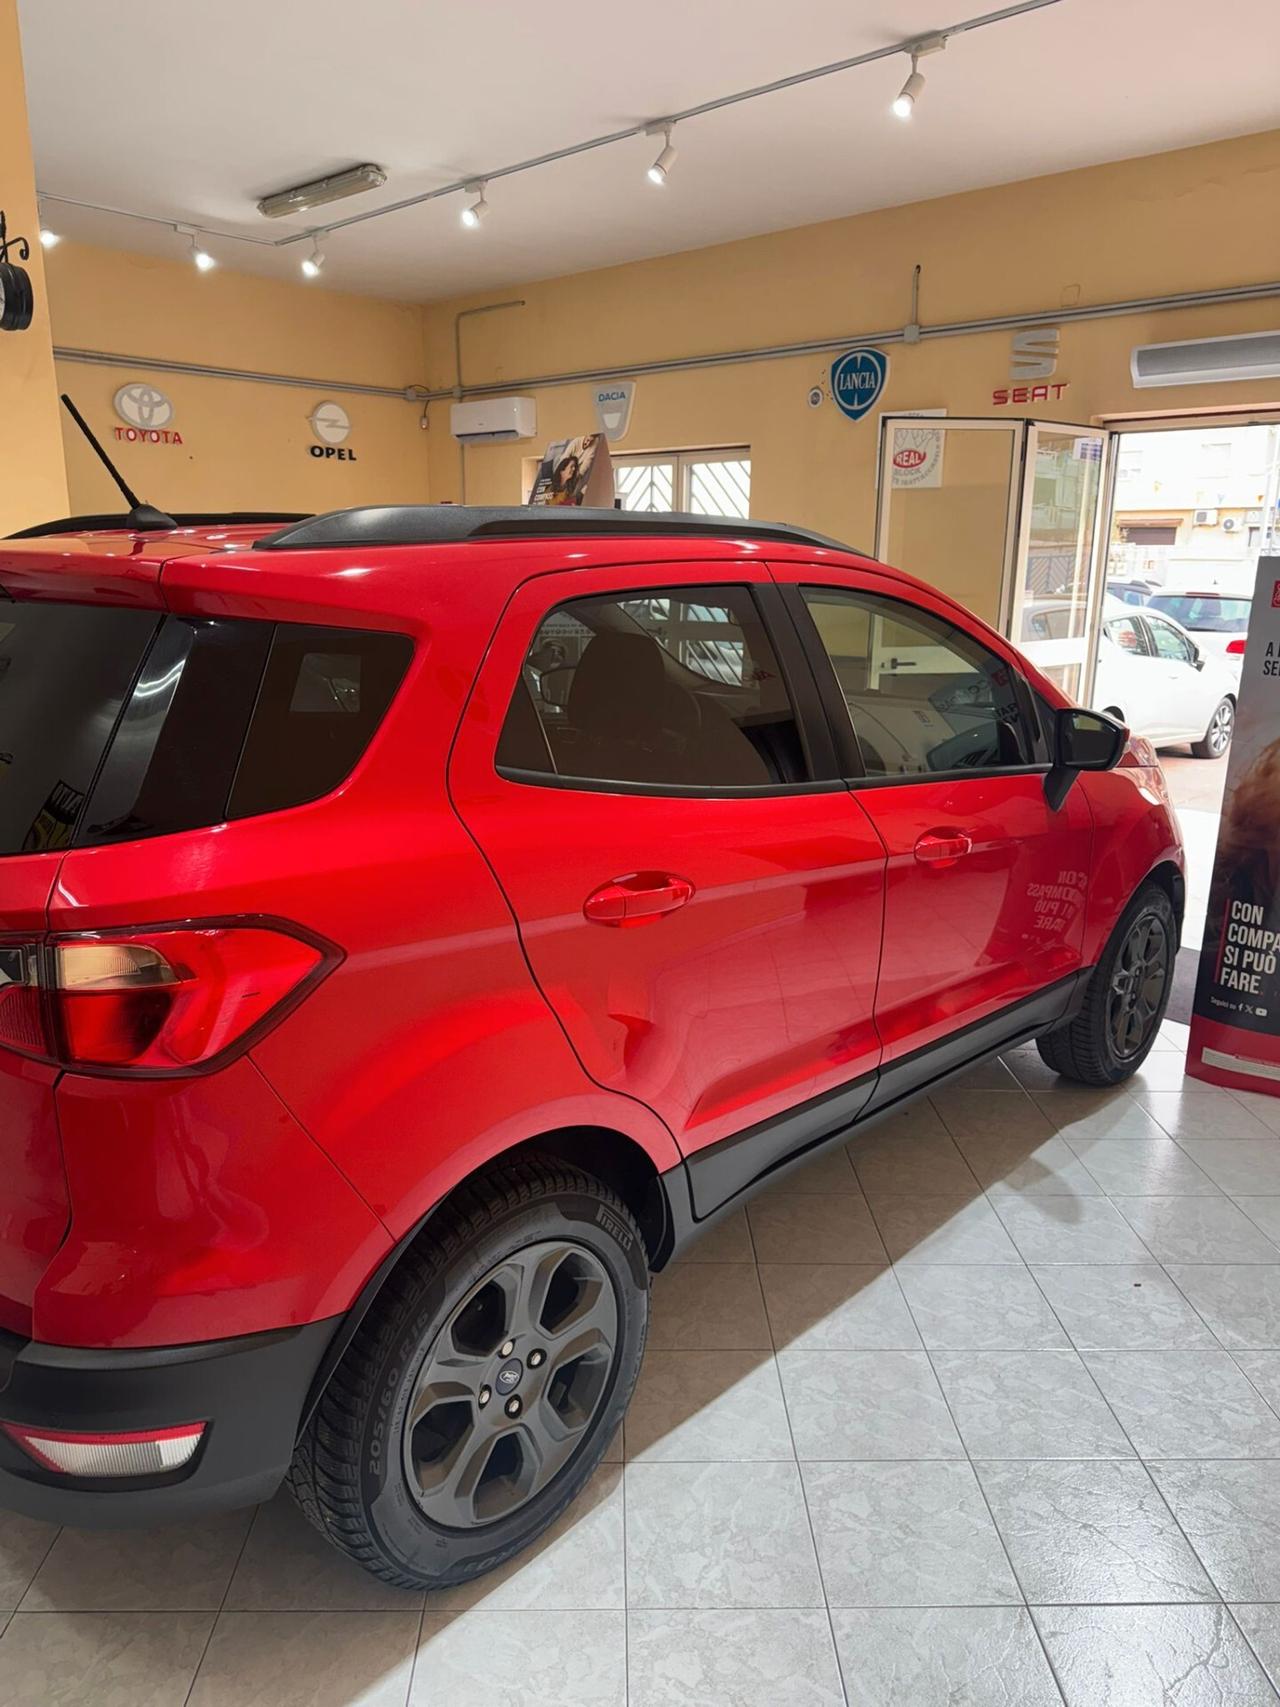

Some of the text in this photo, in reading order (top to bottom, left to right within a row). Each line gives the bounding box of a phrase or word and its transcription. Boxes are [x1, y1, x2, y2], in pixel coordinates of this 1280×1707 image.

[839, 371, 876, 390] LANCIA
[598, 391, 626, 402] DACIA
[992, 383, 1068, 406] SEAT
[114, 427, 183, 445] TOYOTA
[310, 445, 357, 461] OPEL
[896, 451, 921, 466] REAL
[1264, 642, 1274, 657] A
[1263, 659, 1280, 676] SE
[1231, 900, 1264, 926] CON
[1223, 944, 1277, 975] SI PUÒ
[596, 1203, 634, 1251] PIRELLI
[369, 1367, 399, 1475] 205/60
